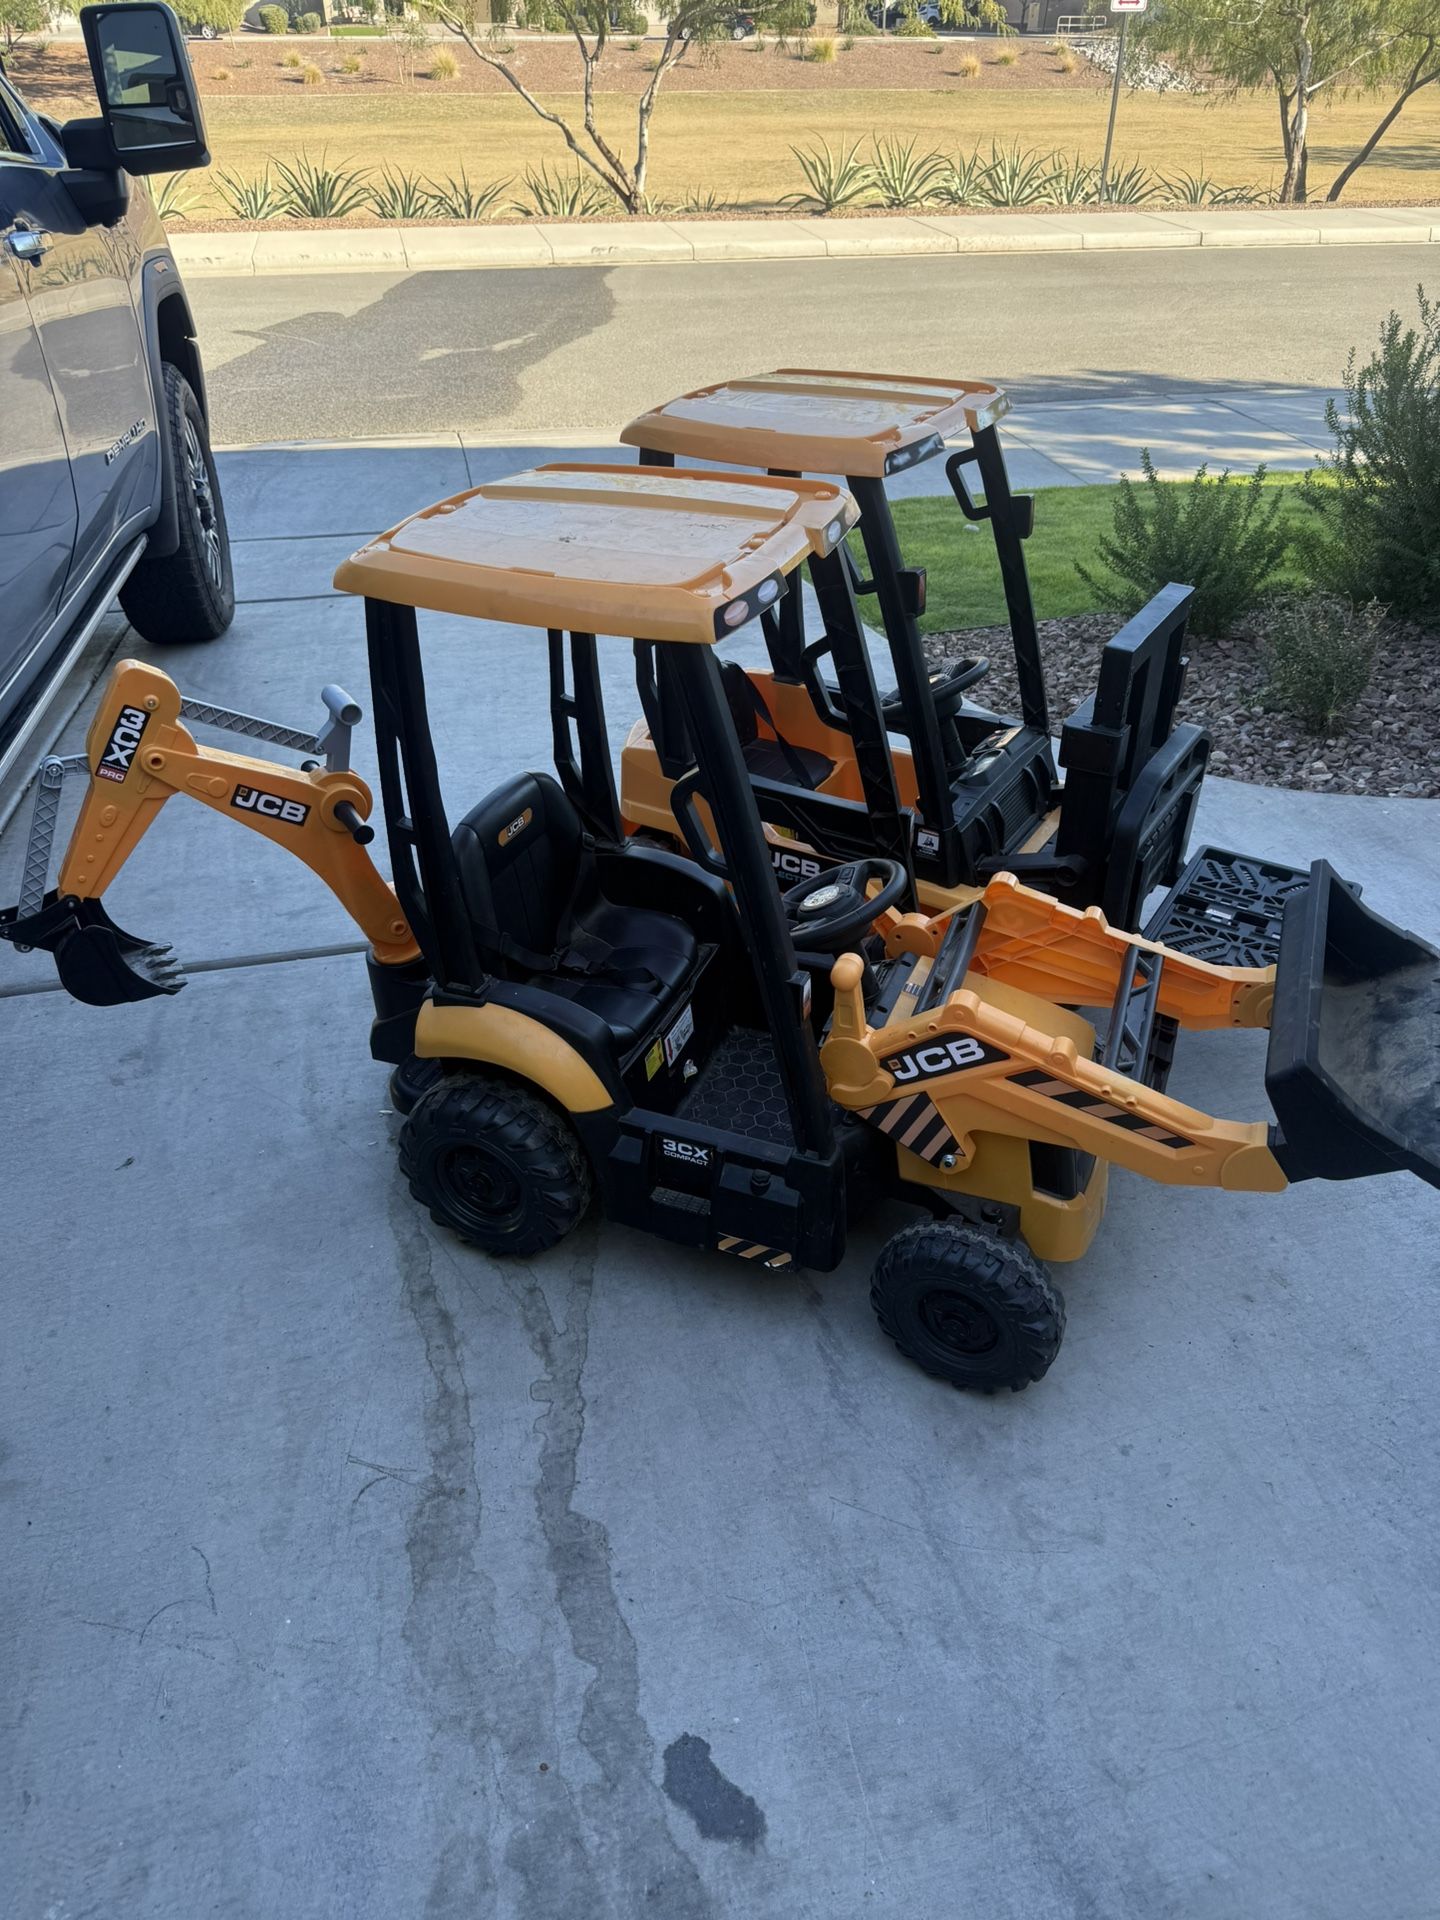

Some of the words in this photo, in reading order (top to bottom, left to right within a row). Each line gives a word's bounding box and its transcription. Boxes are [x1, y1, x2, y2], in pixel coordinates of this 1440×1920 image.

[103, 708, 146, 767] 3CX
[100, 768, 125, 781] PRO
[235, 790, 306, 822] JCB
[508, 816, 525, 836] JCB
[771, 851, 820, 879] JCB
[893, 1037, 985, 1080] JCB
[662, 1138, 709, 1161] 3CX
[663, 1150, 709, 1166] COMPACT
